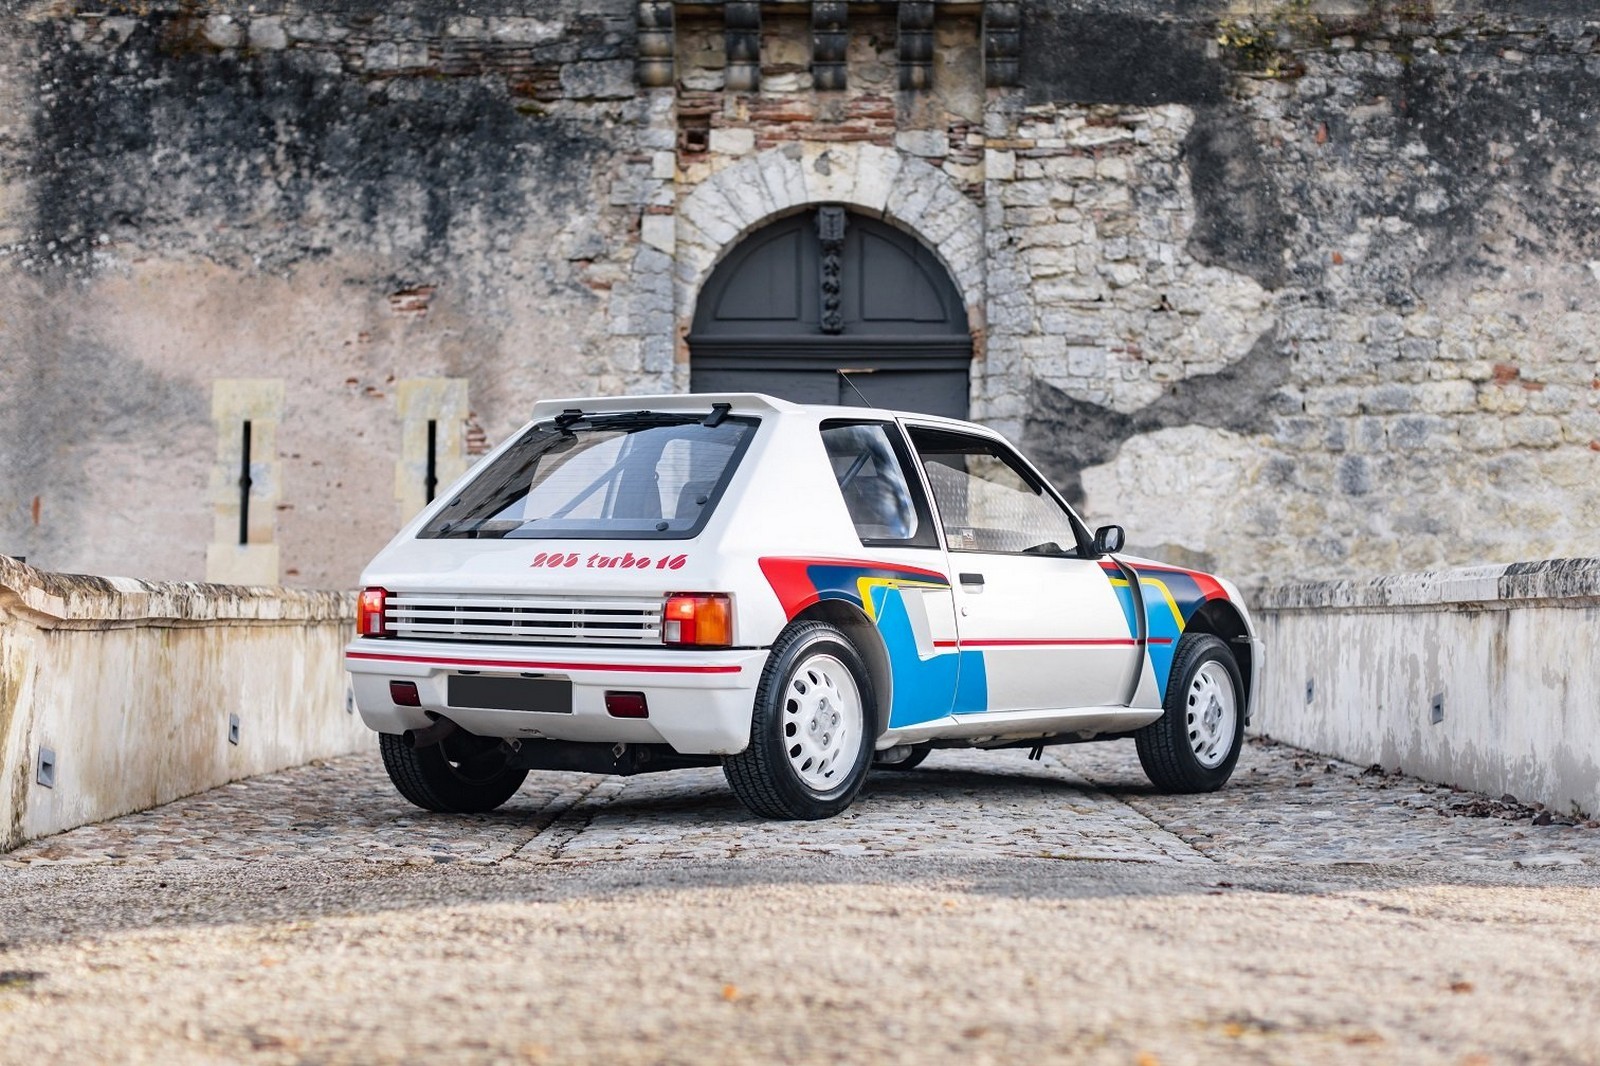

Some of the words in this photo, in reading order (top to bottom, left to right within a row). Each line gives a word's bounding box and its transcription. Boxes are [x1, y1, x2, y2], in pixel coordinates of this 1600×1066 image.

[529, 552, 581, 568] 205
[586, 552, 651, 569] turbo
[655, 554, 689, 570] 16
